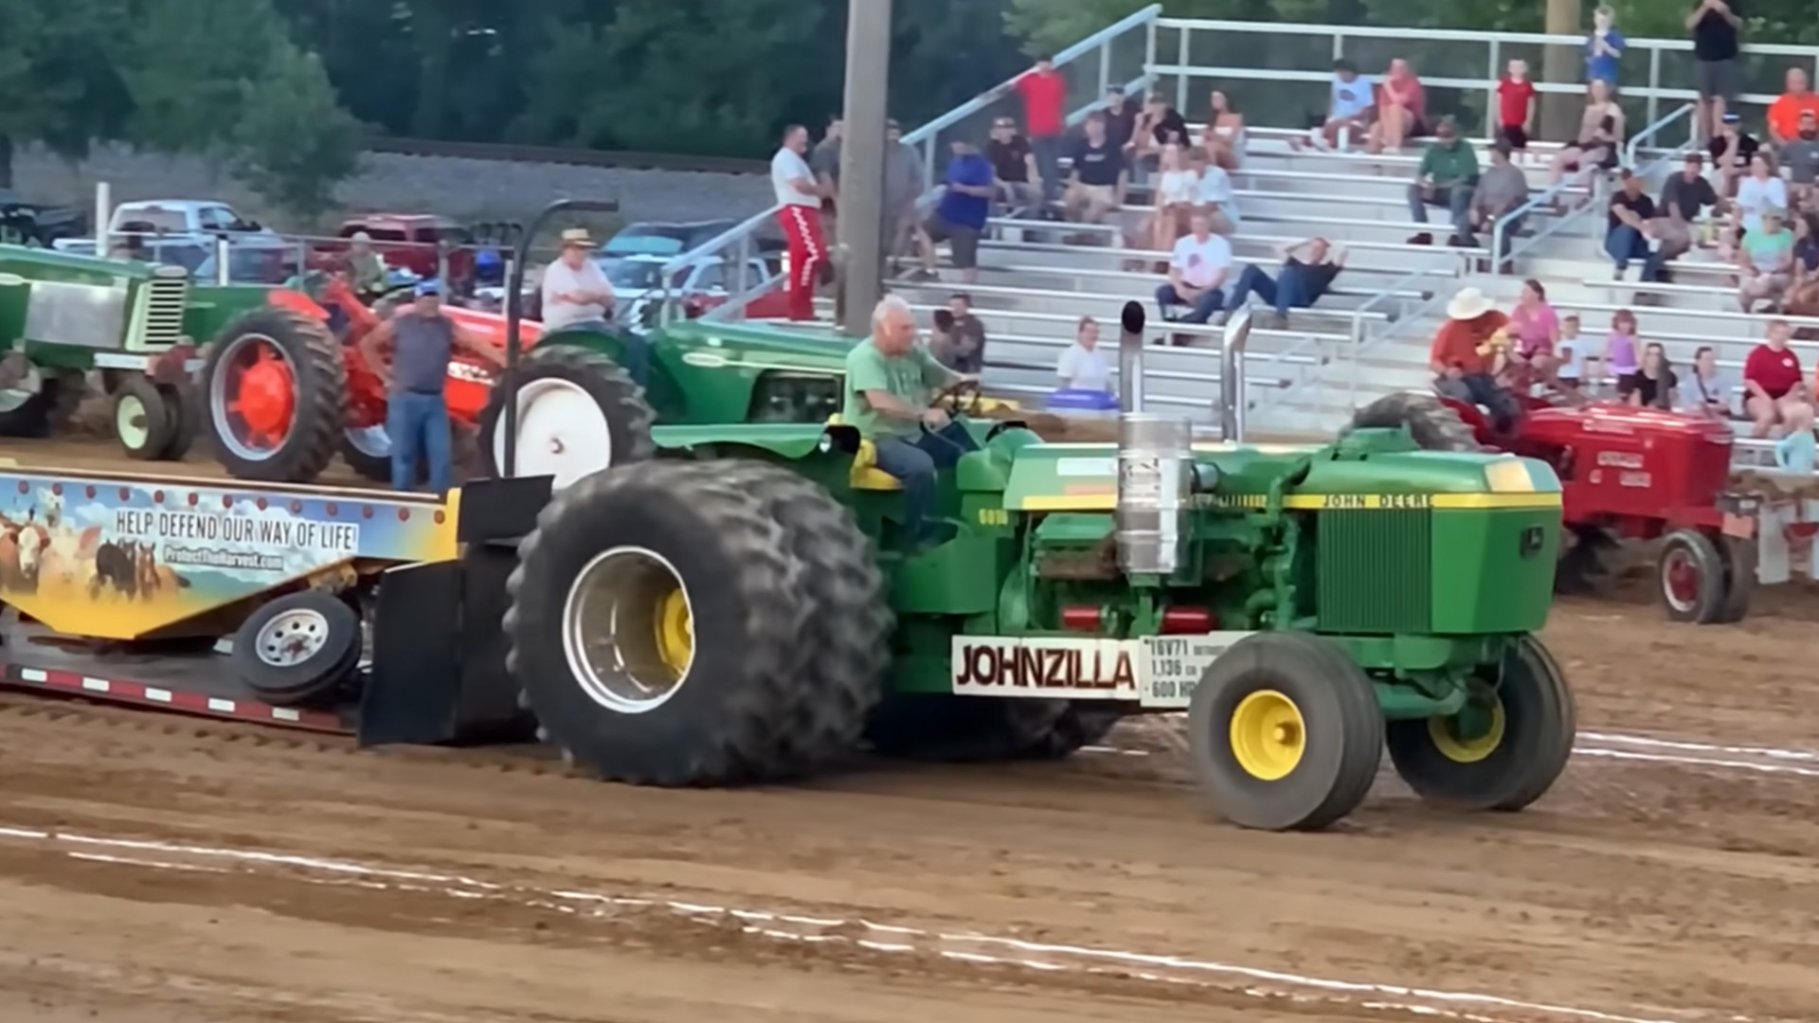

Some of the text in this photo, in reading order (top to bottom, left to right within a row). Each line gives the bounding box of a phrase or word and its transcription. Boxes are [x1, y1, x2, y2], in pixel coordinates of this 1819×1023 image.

[1322, 494, 1434, 509] JOHN DEERE
[116, 510, 357, 550] HELP DEFEND OUR WAY OF LIFE!
[1151, 639, 1188, 656] 16V71
[956, 645, 1136, 690] JOHNZILLA
[1152, 681, 1176, 698] 600
